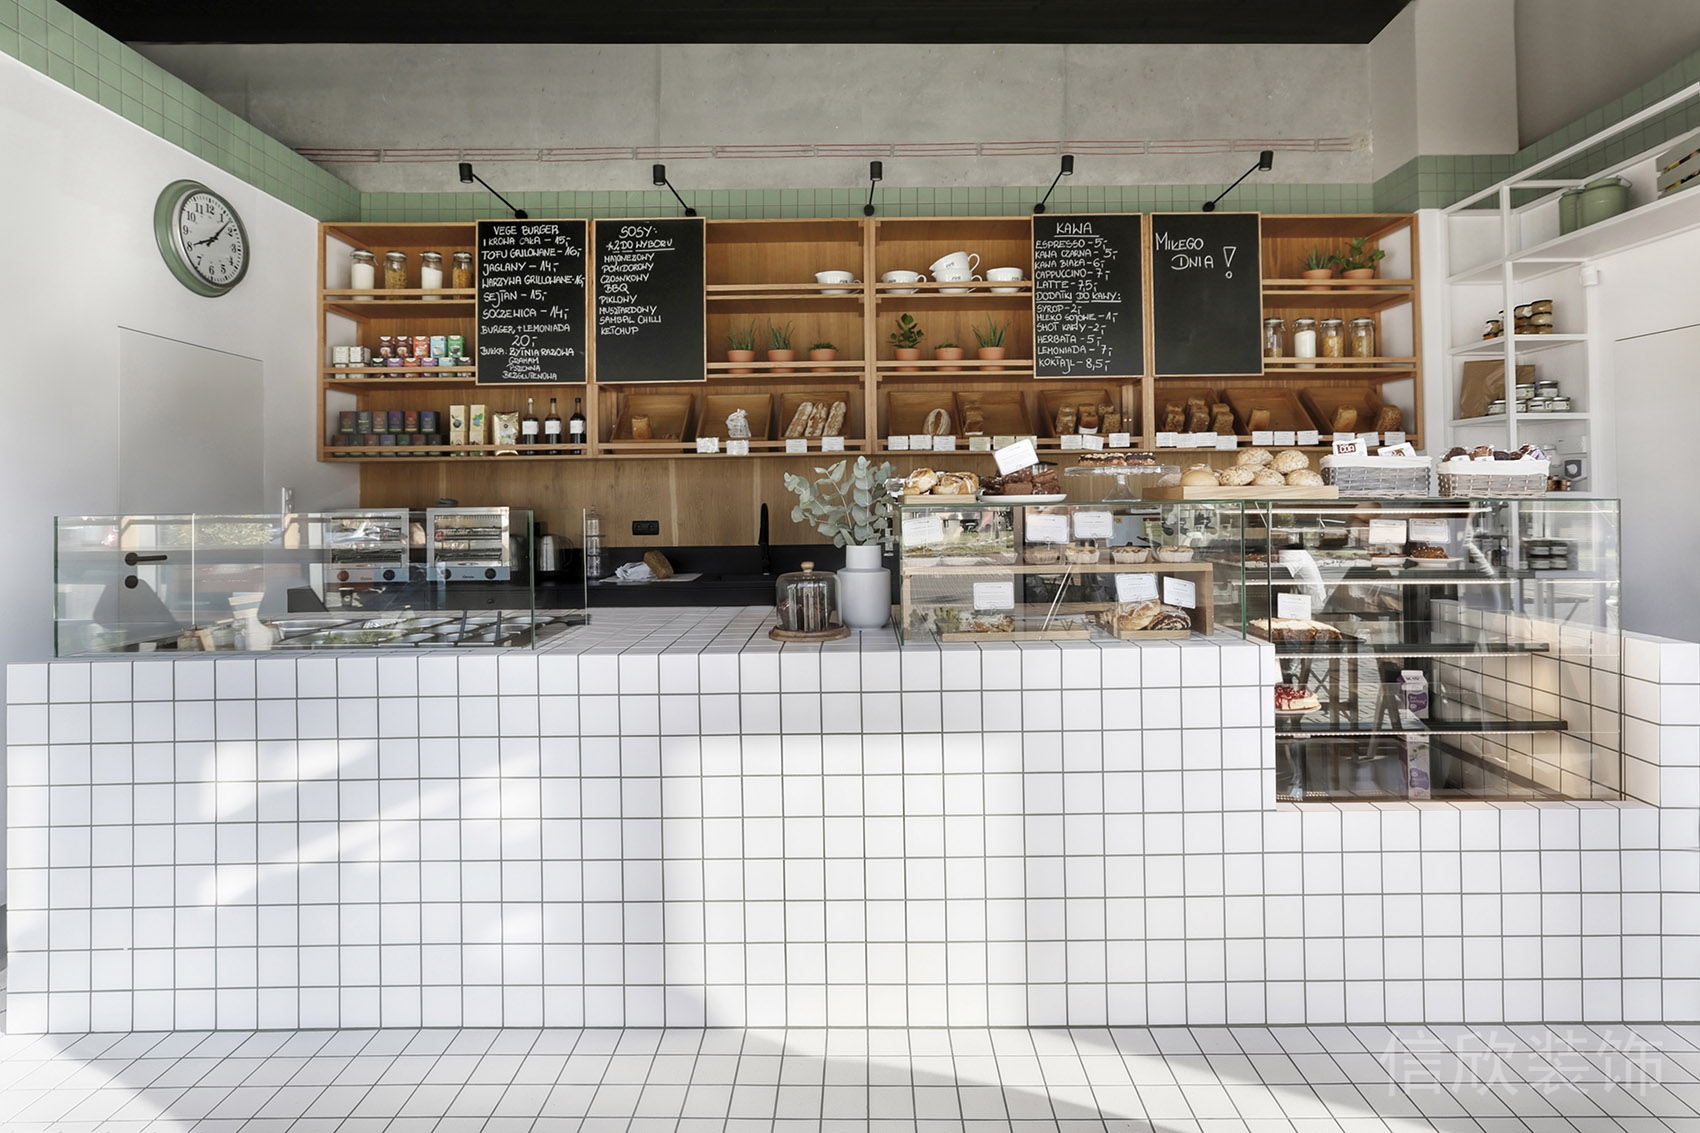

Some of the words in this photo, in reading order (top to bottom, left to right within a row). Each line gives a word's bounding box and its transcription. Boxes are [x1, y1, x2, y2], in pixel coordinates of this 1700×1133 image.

[195, 203, 203, 214] 11
[206, 203, 215, 215] 12
[187, 211, 196, 222] 10
[220, 213, 224, 222] 1
[183, 225, 188, 235] 9
[228, 227, 233, 237] 2
[493, 225, 517, 236] VEGE
[521, 224, 559, 236] BURGER
[619, 225, 658, 239] SOSY:
[1056, 222, 1093, 234] KAWA
[187, 241, 192, 251] 8
[488, 237, 515, 246] KROWA
[1035, 239, 1086, 249] ESPRESSO
[231, 244, 237, 253] 3
[1035, 250, 1058, 259] KAWA
[1061, 248, 1092, 258] CZARNA
[481, 249, 508, 260] TOFU
[604, 252, 655, 267] MAJONEZOWY
[197, 256, 202, 265] 7
[229, 256, 234, 266] 4
[1034, 260, 1057, 270] KAWA
[1171, 254, 1214, 271] DNIA
[209, 265, 215, 275] 6
[221, 264, 226, 274] 5
[482, 261, 527, 276] JAGLANY
[601, 262, 654, 273] POMIDOROWY
[600, 273, 650, 284] CZOSNKOWY
[1035, 268, 1087, 279] CAPPUCCINO
[481, 275, 521, 289] WARZYWA
[1036, 280, 1069, 289] LATTE
[604, 283, 630, 294] BBQ
[483, 289, 517, 308] SEJTAN
[599, 294, 638, 305] PIKLOWY
[1035, 290, 1073, 301] DODATKI
[1076, 292, 1090, 300] DO
[482, 308, 537, 320] SOCZEWICA
[599, 305, 657, 315] MUSZTARDOWY
[1036, 304, 1064, 313] SYROP
[599, 315, 635, 325] SAMBAL
[637, 315, 661, 324] CHILLI
[1064, 313, 1097, 326] SOJOWE
[601, 325, 639, 336] KETCHUP
[1036, 321, 1060, 332] SHOT
[1062, 323, 1087, 333] KAWY
[1037, 333, 1077, 344] HERBATA
[540, 348, 575, 357] RAZOWA
[1037, 345, 1087, 355] LEMONIADA
[508, 357, 539, 365] GRAHAM
[1038, 356, 1075, 374] KOKTAJL
